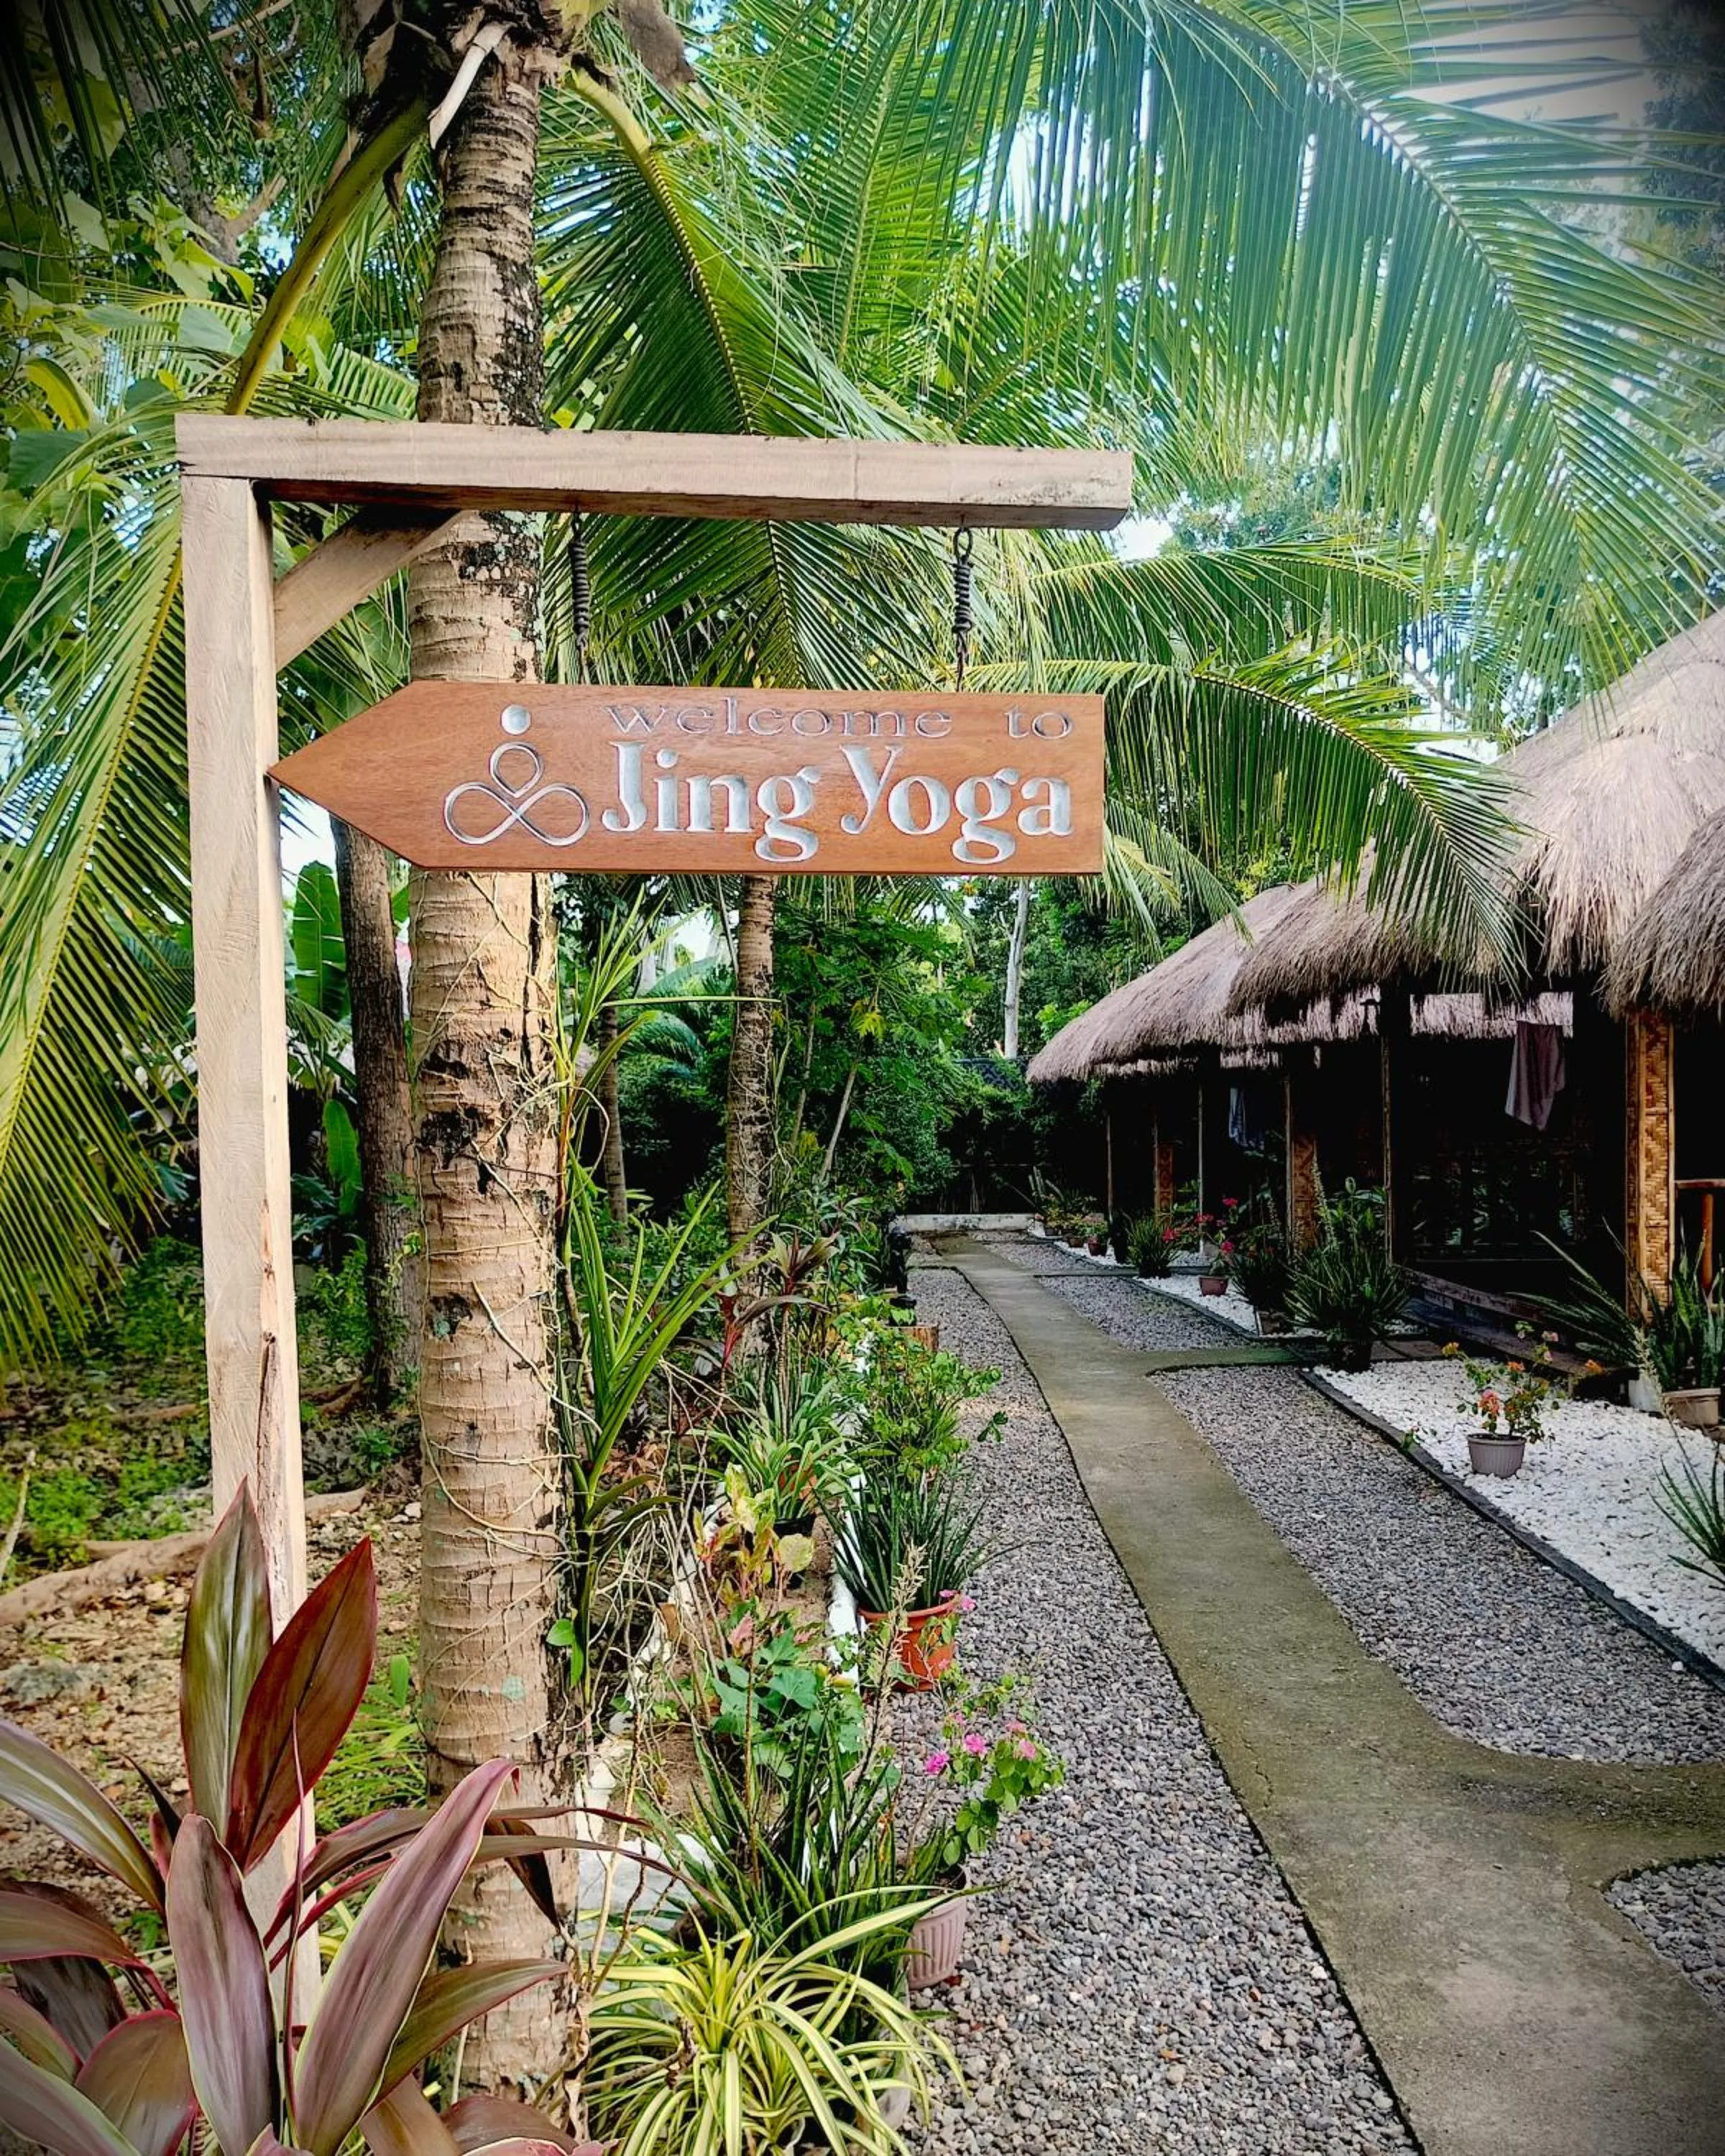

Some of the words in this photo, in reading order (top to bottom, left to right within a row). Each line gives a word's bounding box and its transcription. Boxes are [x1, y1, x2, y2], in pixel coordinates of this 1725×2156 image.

[604, 695, 952, 738] welcome
[1005, 704, 1072, 740] to
[601, 741, 822, 862] Jing
[839, 743, 1075, 865] Yoga
